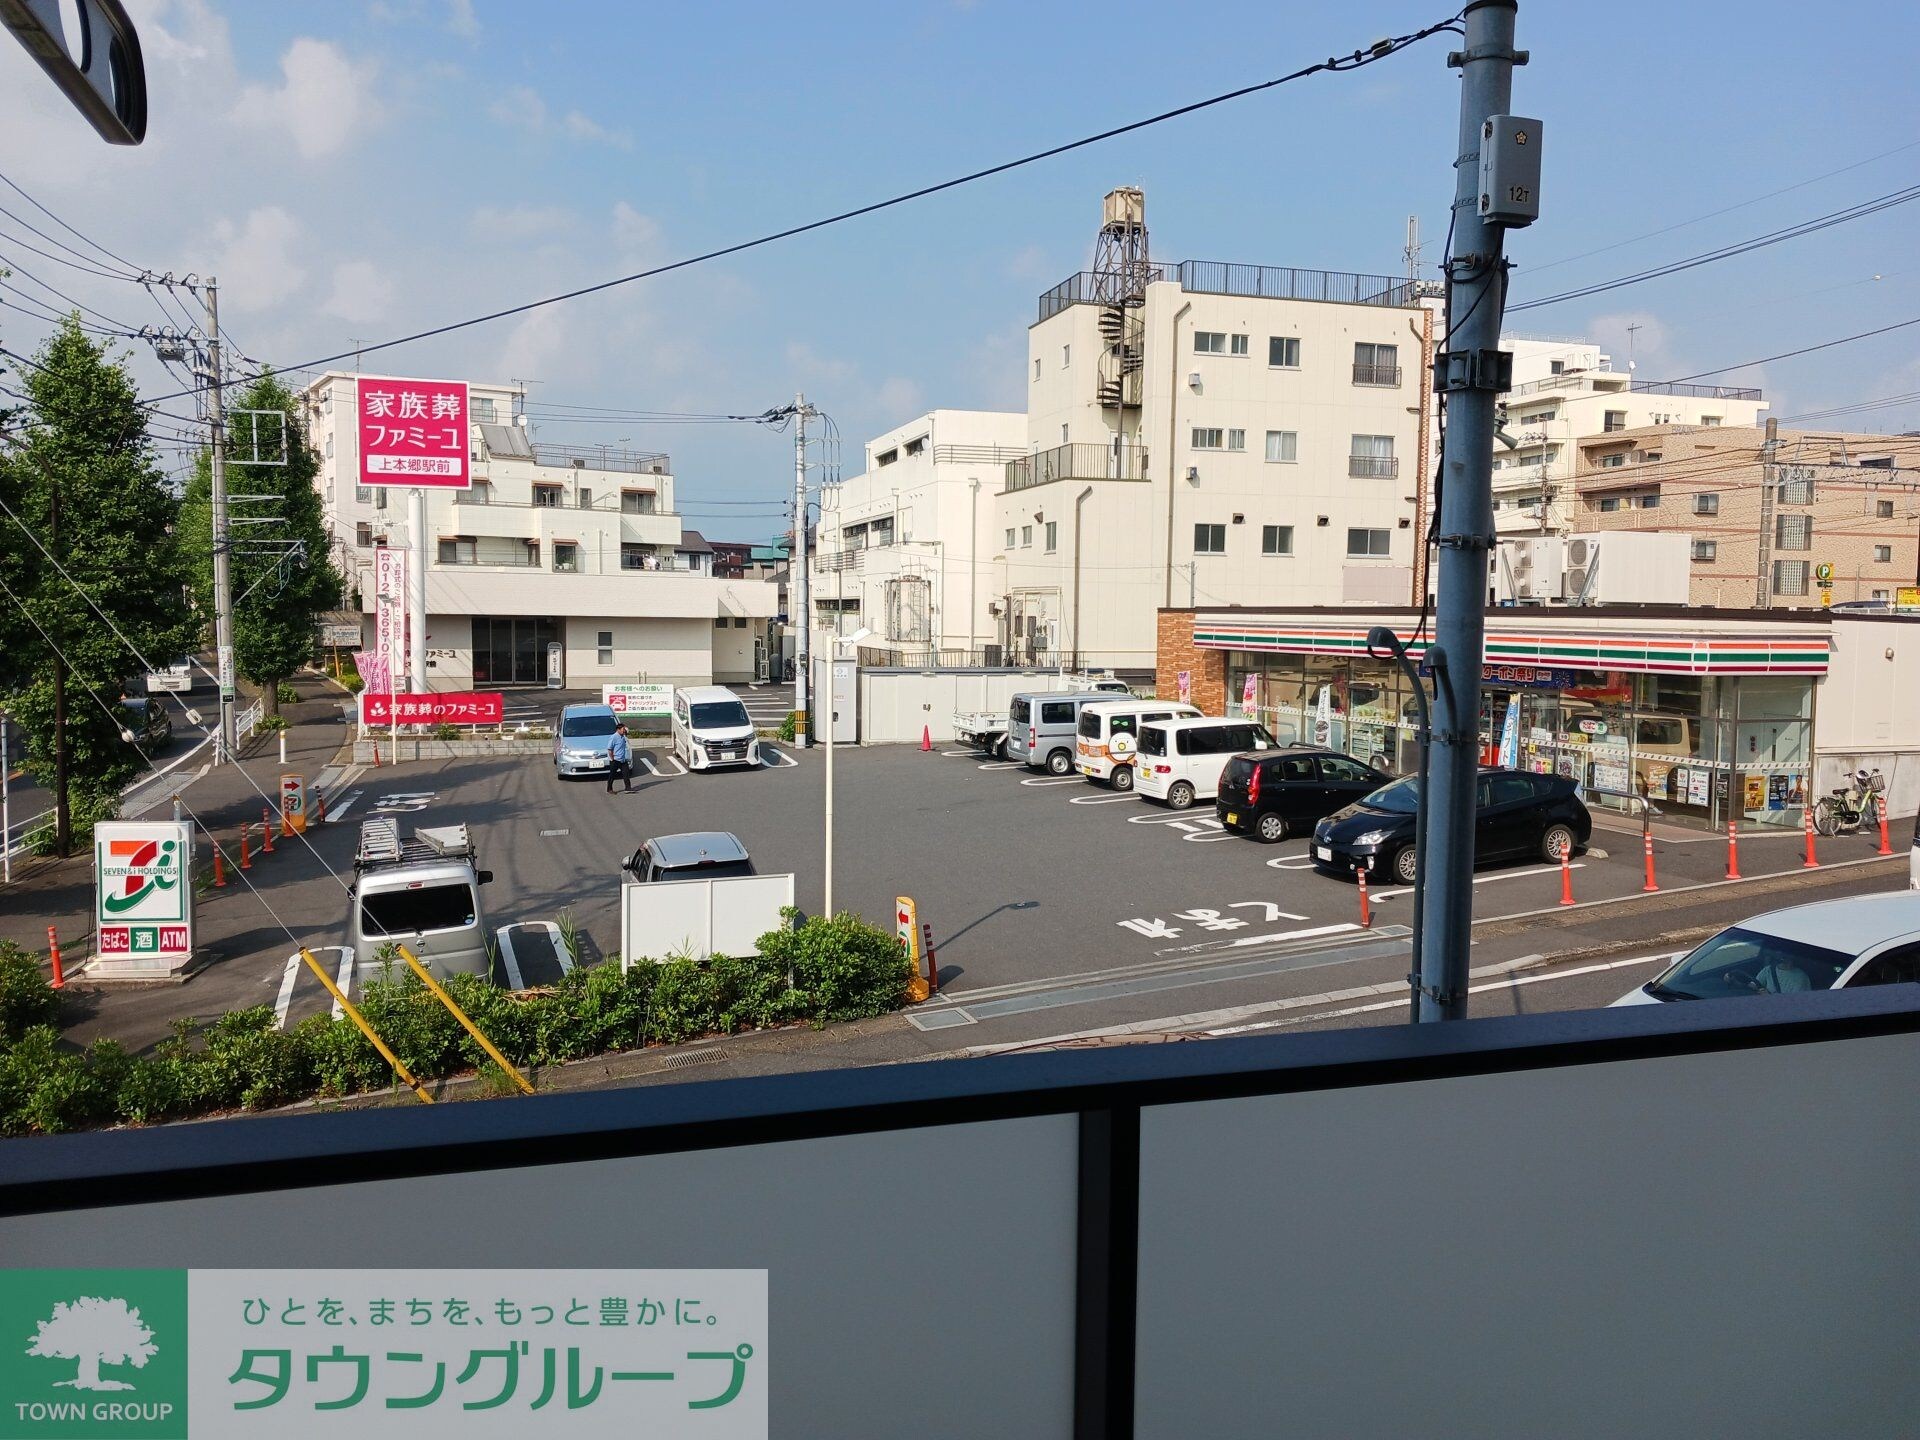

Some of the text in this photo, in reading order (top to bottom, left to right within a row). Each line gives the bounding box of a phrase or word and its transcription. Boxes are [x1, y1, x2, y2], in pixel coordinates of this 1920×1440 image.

[1510, 187, 1530, 203] 12T
[364, 390, 461, 421] 家族葬
[366, 425, 461, 450] ファミーユ
[379, 457, 450, 473] 上本郷駅前
[1821, 566, 1830, 577] P
[389, 703, 496, 716] 家族葬のファミーユ
[138, 867, 177, 875] HOLDINGS
[1116, 901, 1311, 939] とまれ
[101, 930, 186, 949] たばこ 酒 ATM
